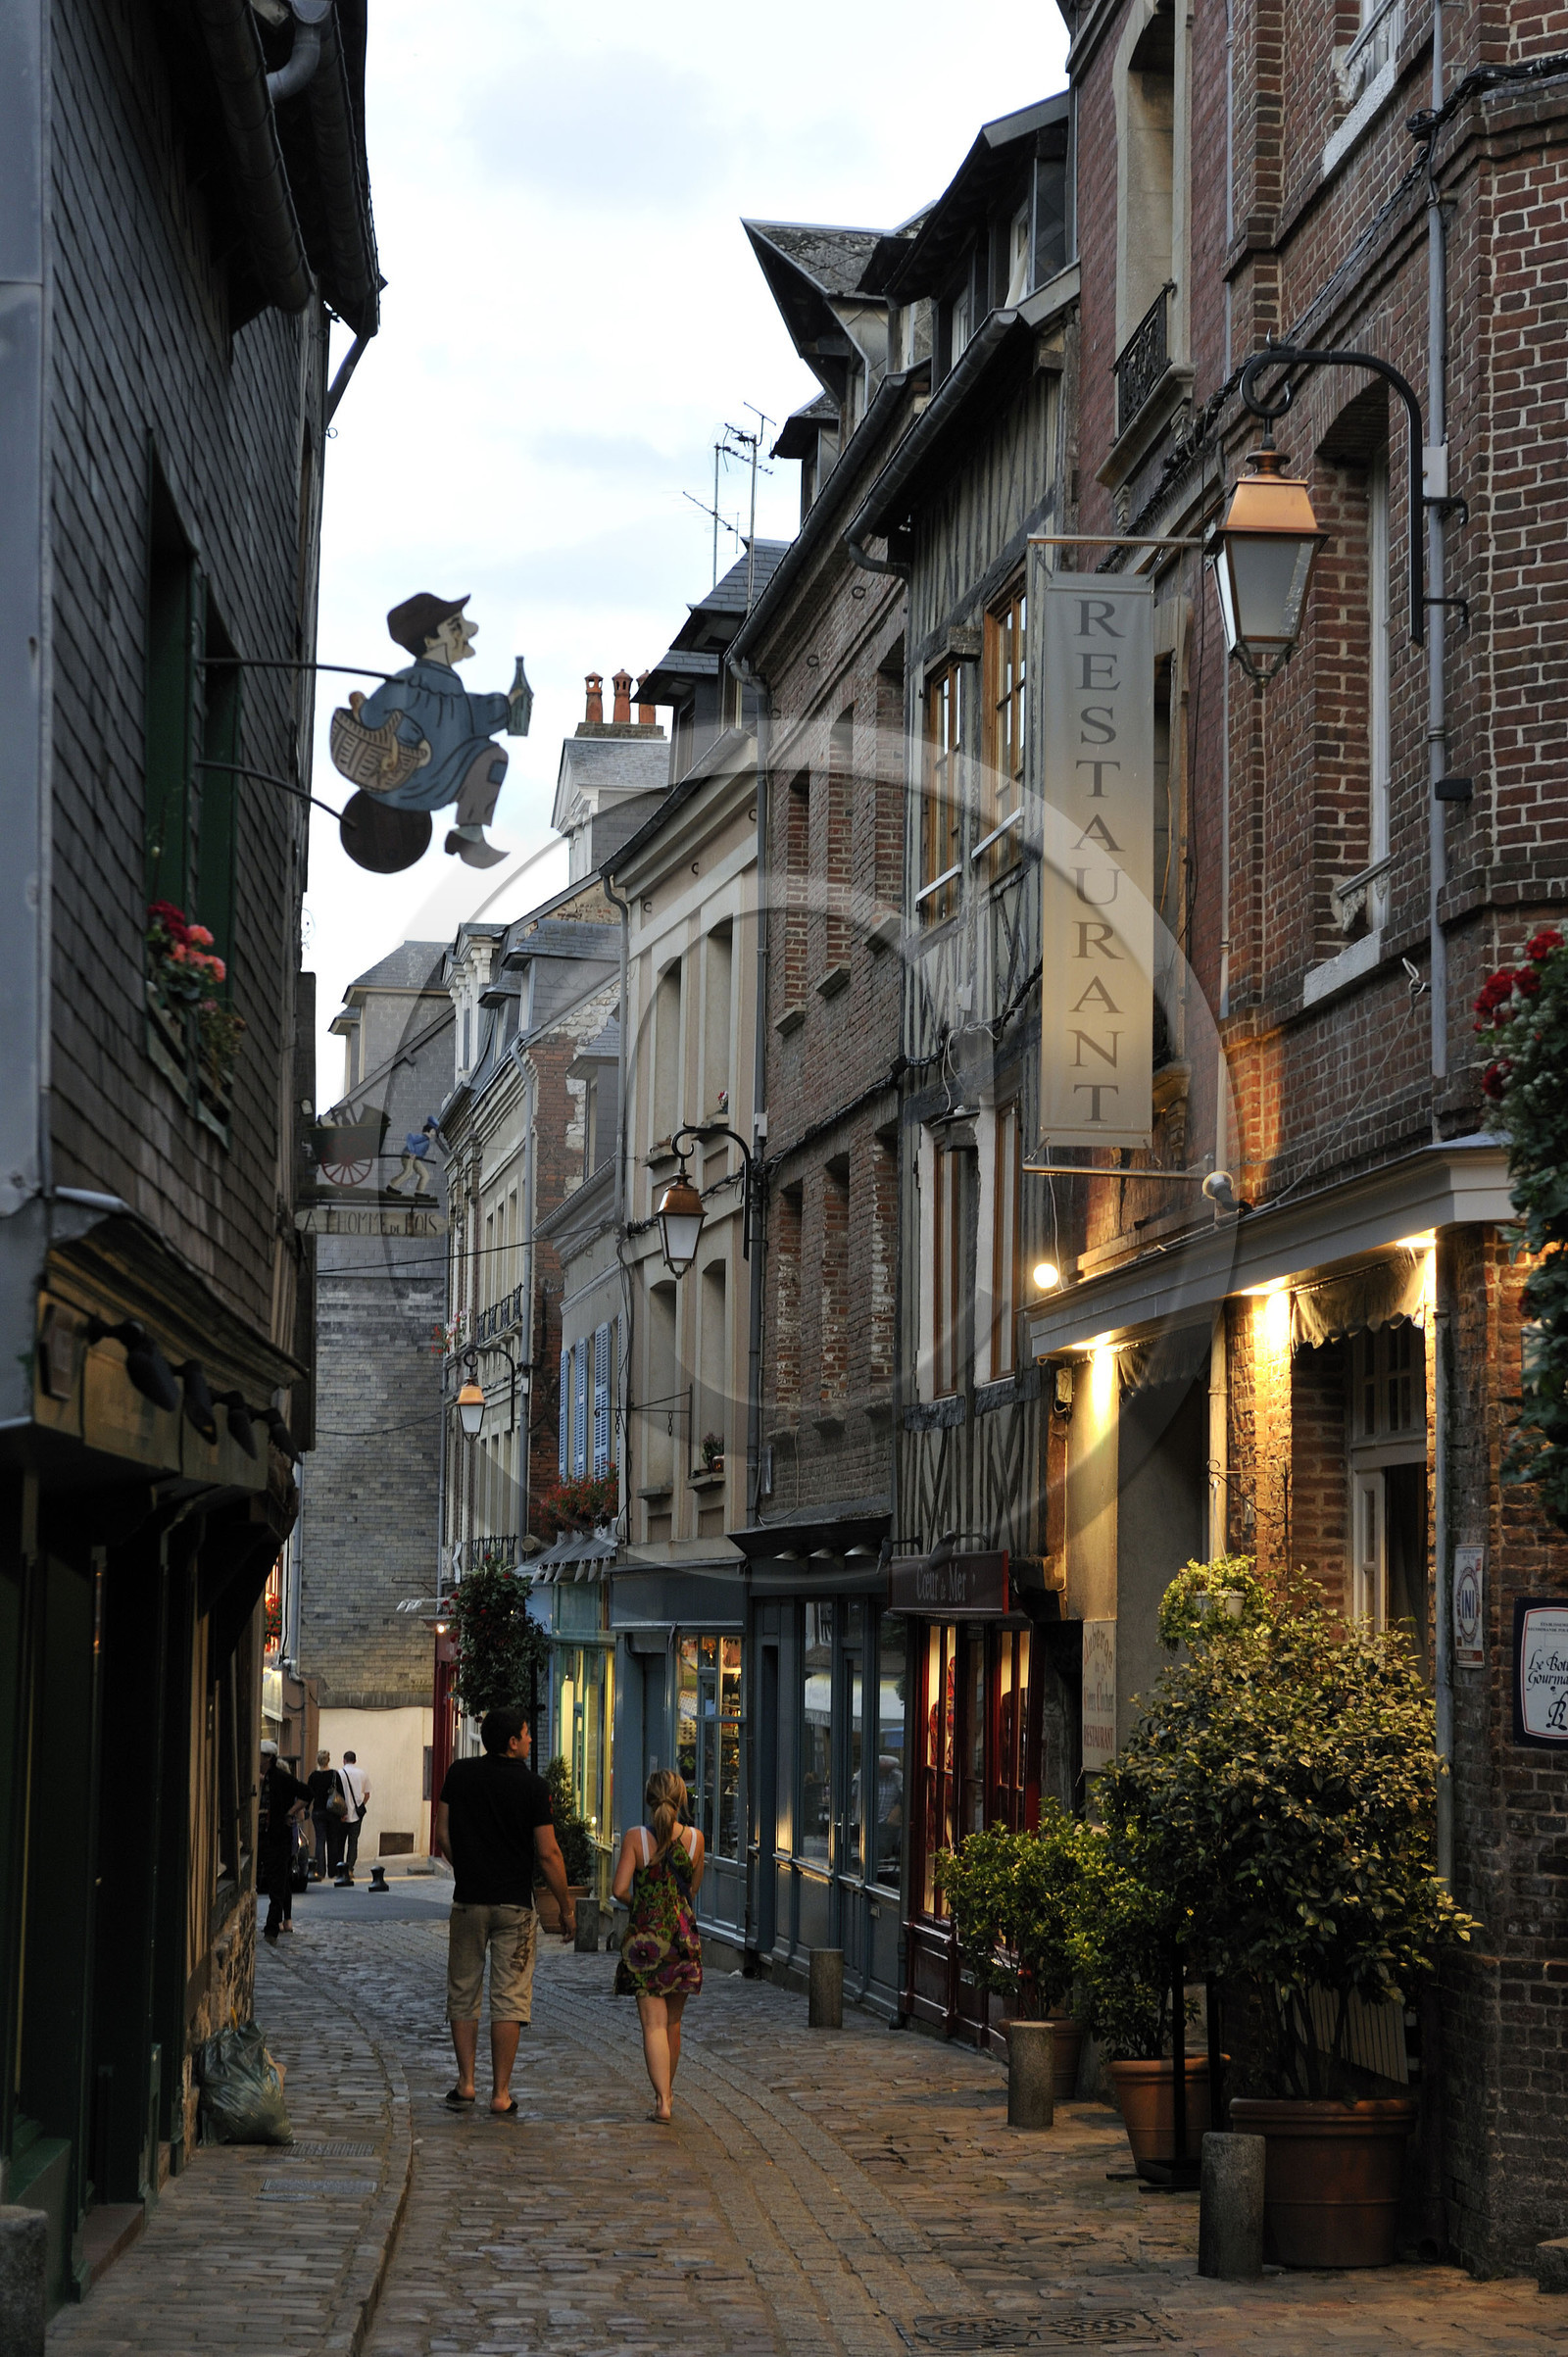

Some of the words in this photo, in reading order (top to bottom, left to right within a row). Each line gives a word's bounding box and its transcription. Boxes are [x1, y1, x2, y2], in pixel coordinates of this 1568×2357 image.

[1069, 599, 1125, 1122] RESTAURANT
[304, 1210, 318, 1232] A
[948, 1561, 967, 1603] Mer
[1527, 1648, 1544, 1670] Le
